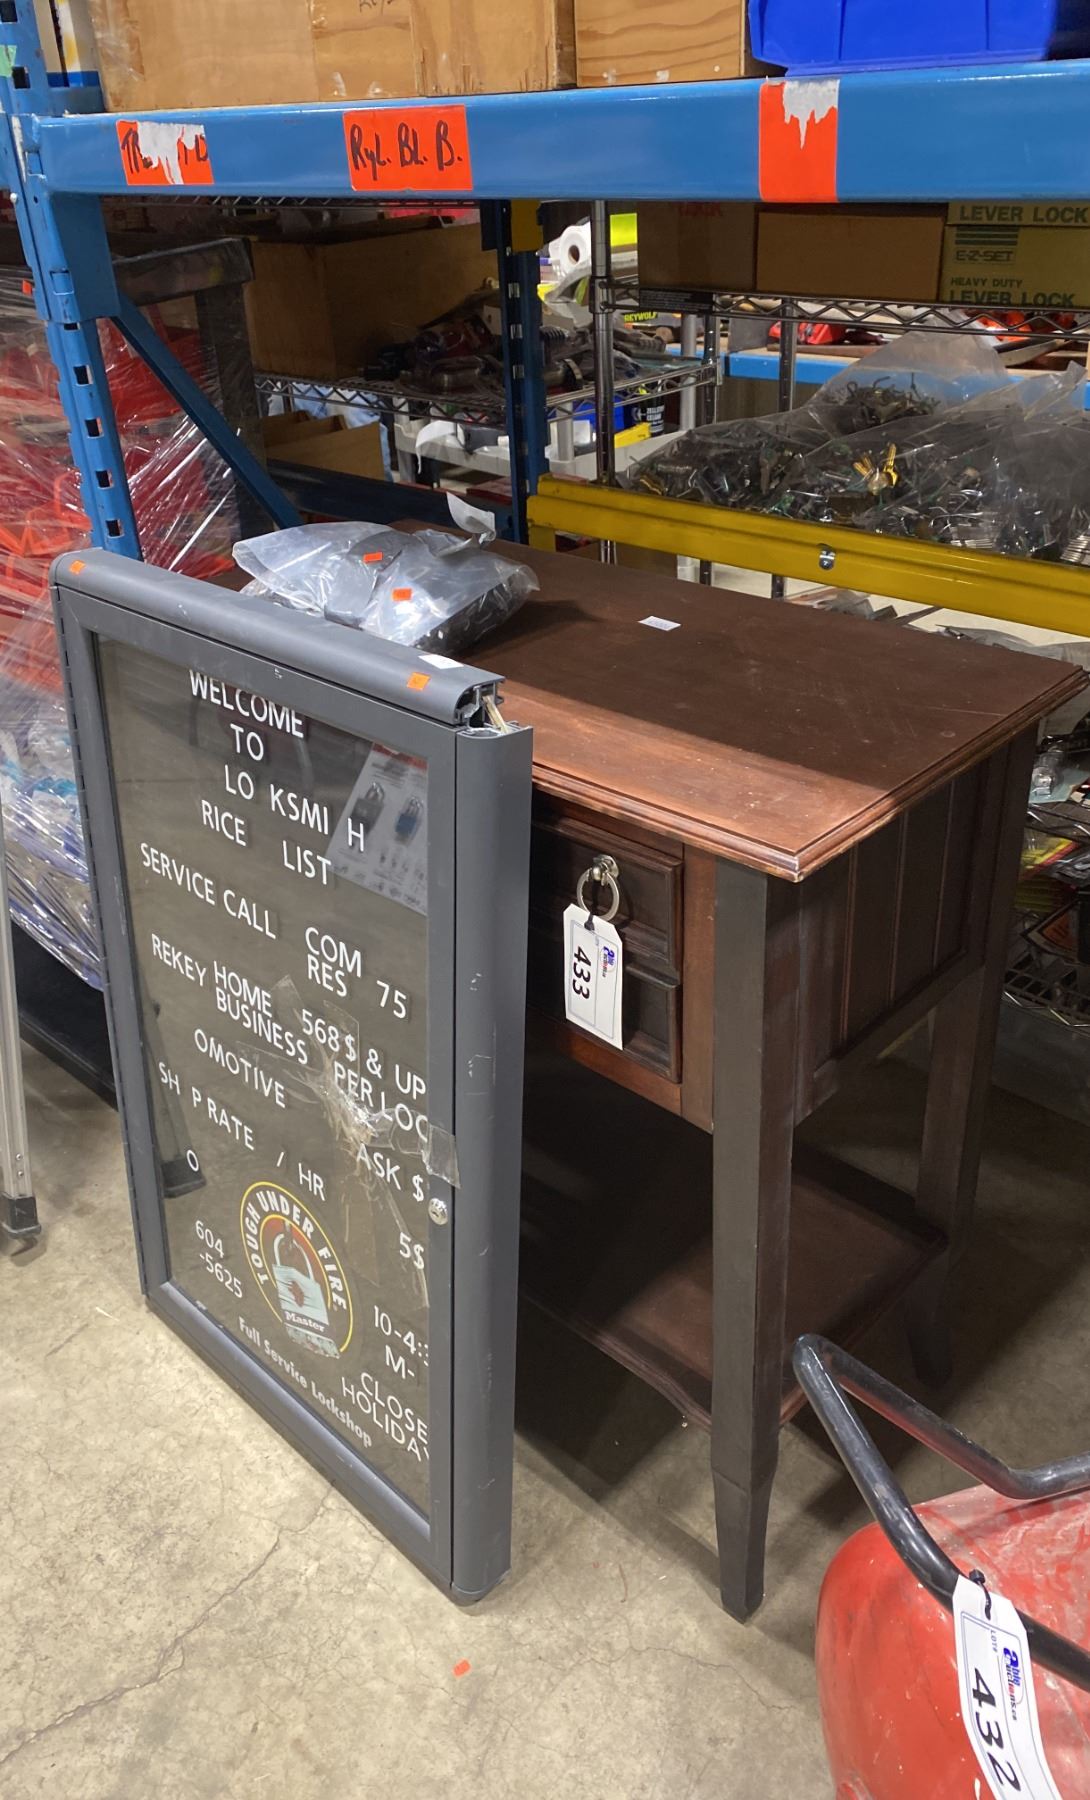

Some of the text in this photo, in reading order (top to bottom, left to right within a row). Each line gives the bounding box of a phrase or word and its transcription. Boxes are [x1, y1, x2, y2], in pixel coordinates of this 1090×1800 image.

[959, 205, 1089, 223] LEVER LOCK
[949, 290, 1076, 307] LEVER LOCK
[951, 277, 1023, 288] HEAVY DUTY
[189, 669, 304, 738] WELCOME
[230, 723, 265, 761] TO
[201, 799, 331, 885] RICE LIST
[224, 764, 364, 852] LO KSMI H
[140, 843, 362, 978] SERVICE CALL COM
[308, 953, 407, 1019] RES 75
[572, 946, 592, 1000] 433
[151, 933, 207, 987] REKEY
[213, 960, 273, 1018] HOME
[366, 1048, 382, 1079] &
[395, 1064, 426, 1100] UP
[216, 987, 308, 1065] BUSINESS
[334, 1060, 374, 1107] PER
[158, 1061, 180, 1096] SH
[191, 1086, 202, 1108] P
[207, 1097, 255, 1151] RATE
[298, 1162, 326, 1201] HR
[194, 1028, 425, 1202] OMOTIVE ASK $
[195, 1219, 225, 1258] 604
[245, 1190, 347, 1310] TOUGH UNDER FIRE
[399, 1231, 425, 1270] 5$
[284, 1310, 325, 1332] Master
[239, 1315, 372, 1448] Full Service Lockshop
[341, 1376, 430, 1462] HOLIDA
[361, 1372, 428, 1445] CLOSE
[972, 1667, 1022, 1792] 432
